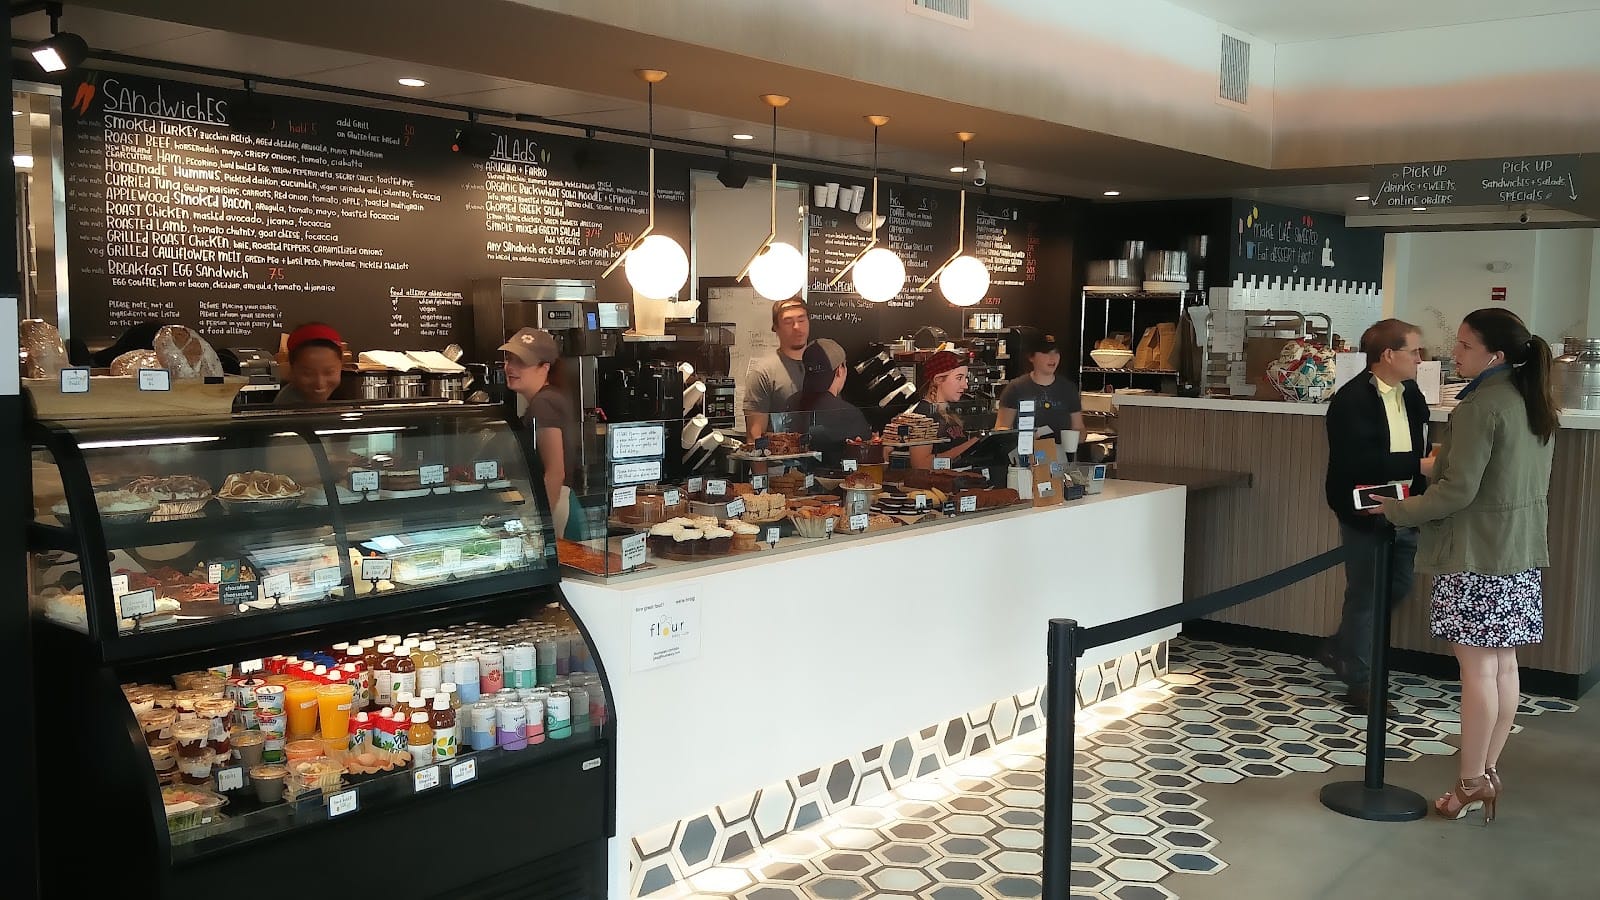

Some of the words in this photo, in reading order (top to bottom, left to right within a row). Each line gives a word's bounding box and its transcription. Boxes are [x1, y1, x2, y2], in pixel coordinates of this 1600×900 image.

[1402, 165, 1430, 179] Pick
[1433, 164, 1447, 177] UP
[1502, 160, 1531, 173] Pick
[1535, 160, 1553, 172] UP
[88, 248, 104, 257] veg
